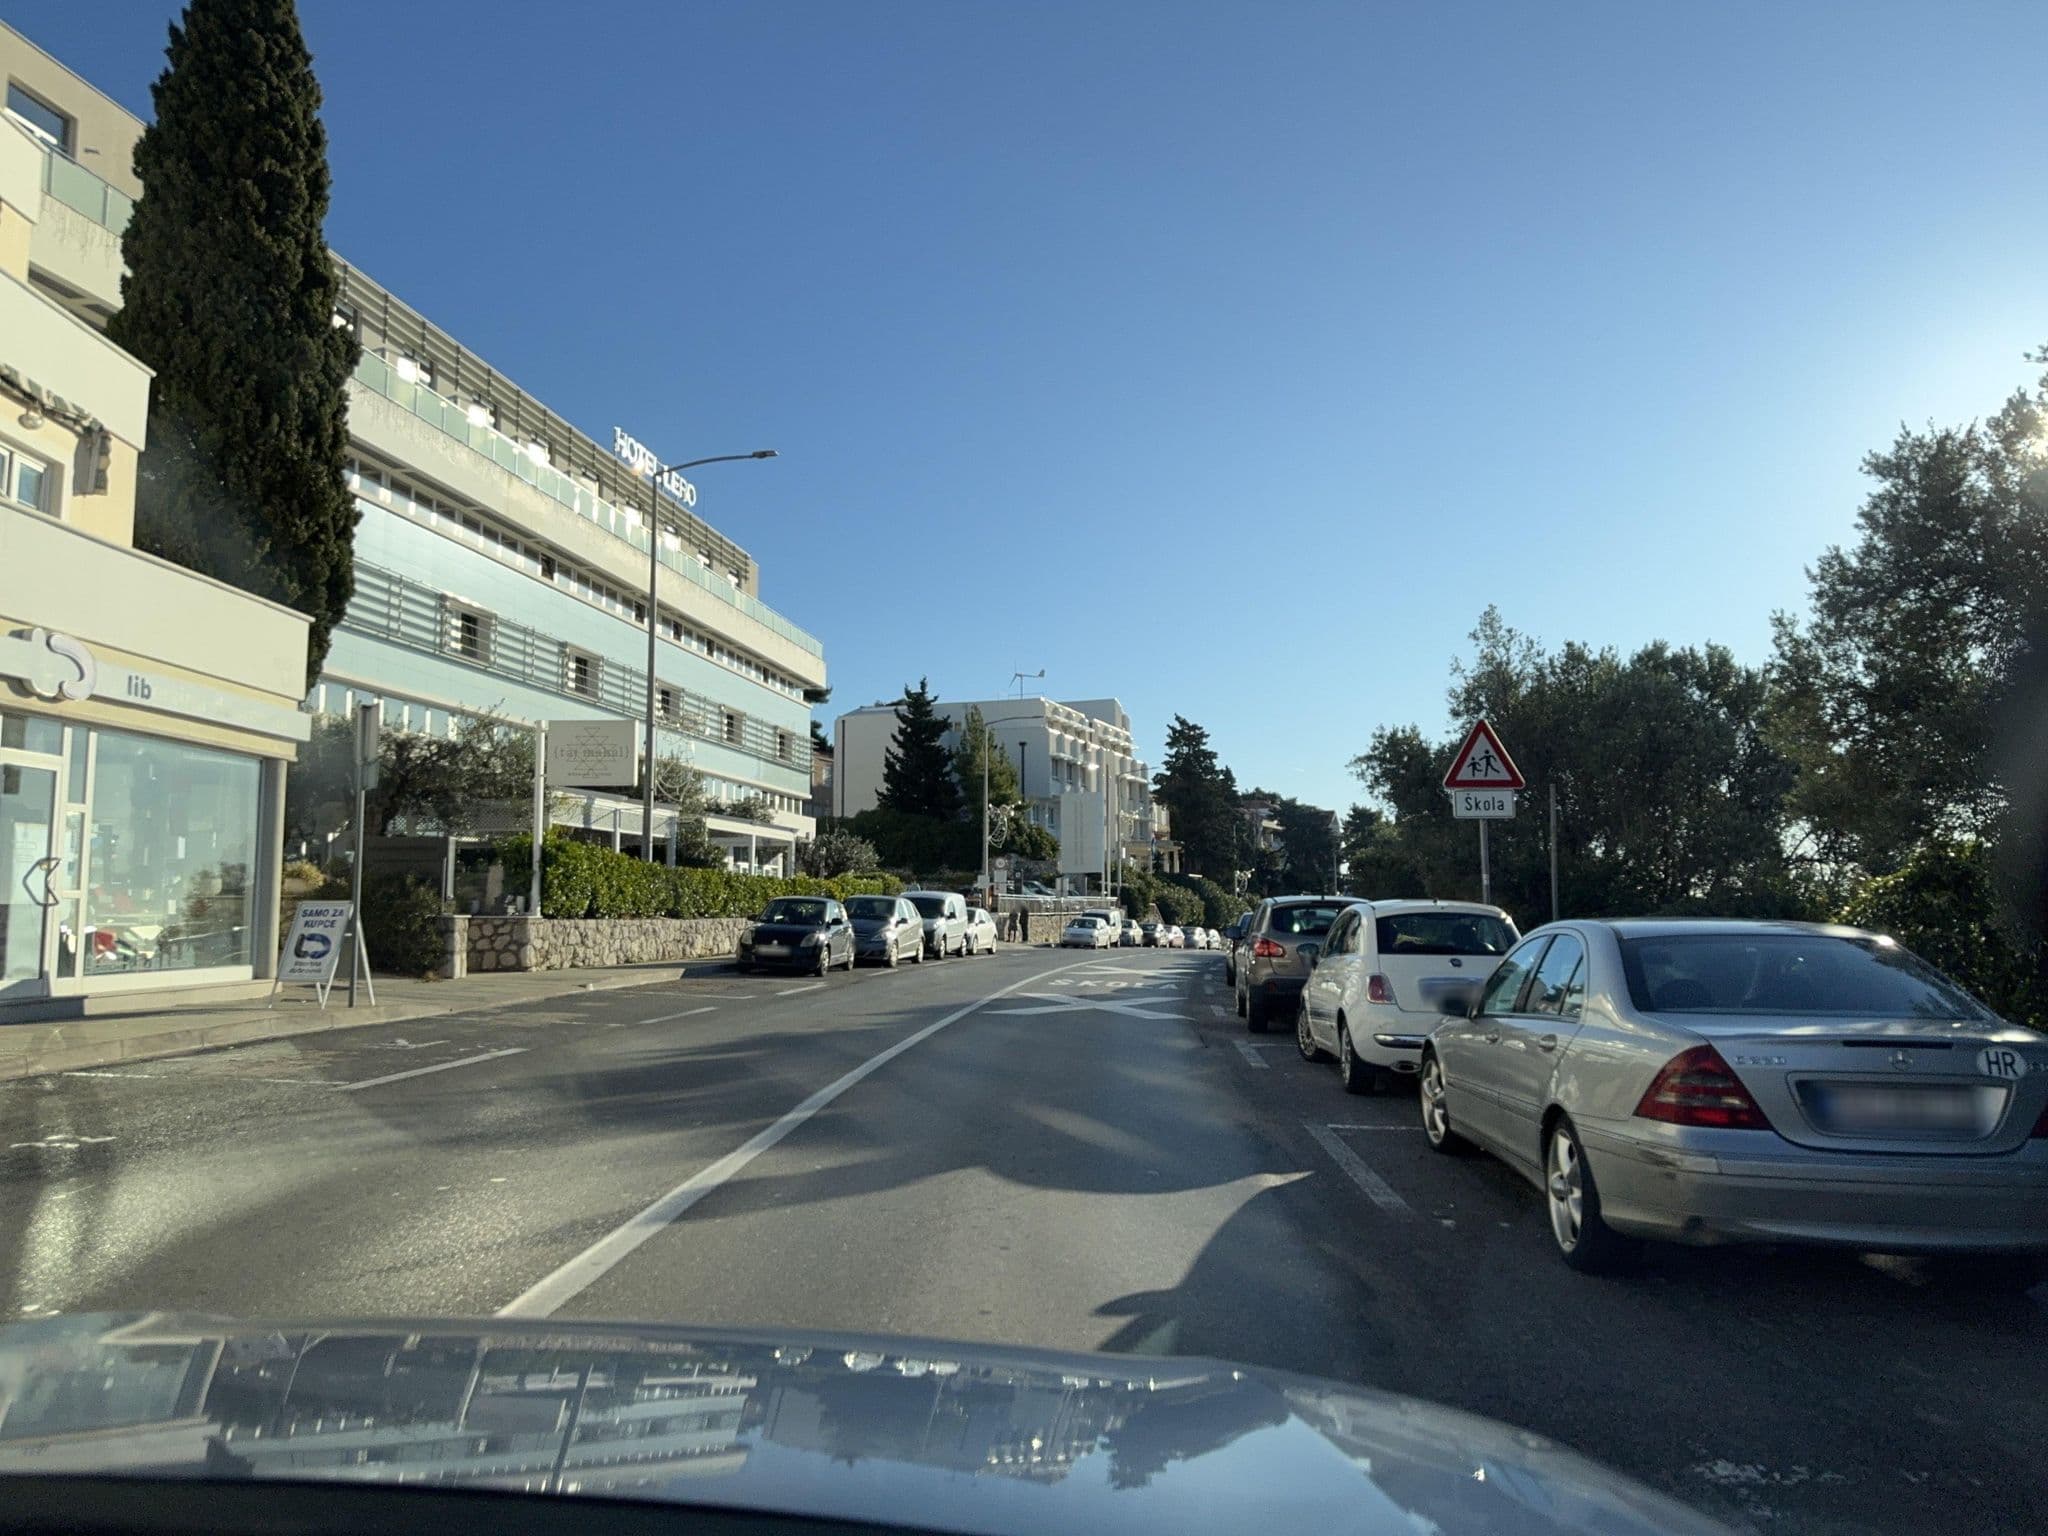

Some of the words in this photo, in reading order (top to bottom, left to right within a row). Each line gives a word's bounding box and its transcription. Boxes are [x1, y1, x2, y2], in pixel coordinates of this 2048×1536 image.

[614, 426, 662, 483] HOTEL
[127, 675, 152, 700] lib
[1465, 793, 1505, 811] Škola
[302, 908, 330, 918] SAMO
[331, 908, 345, 918] ZA
[304, 919, 337, 929] KUPCE
[1985, 1050, 2018, 1077] HR
